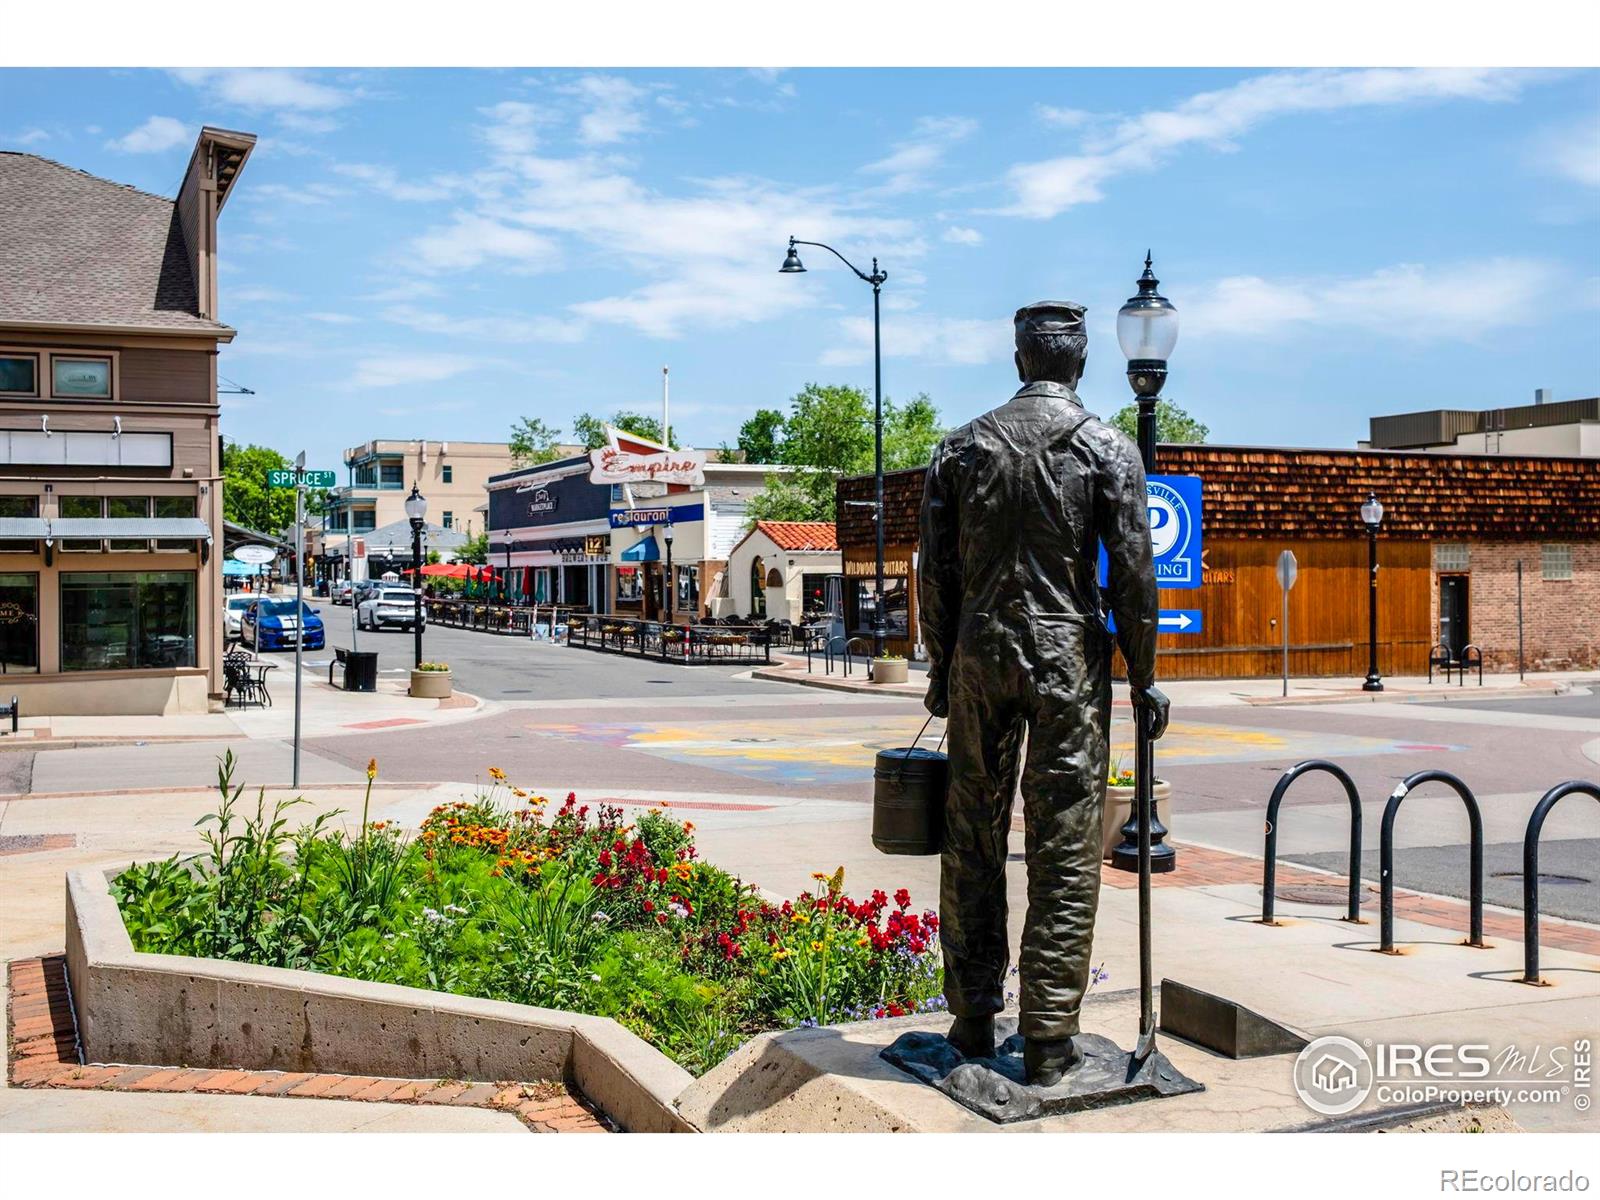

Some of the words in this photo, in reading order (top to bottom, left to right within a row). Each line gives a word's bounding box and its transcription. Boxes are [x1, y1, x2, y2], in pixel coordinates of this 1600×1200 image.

[602, 455, 697, 479] Empire
[272, 471, 321, 485] SPRUCE
[1146, 486, 1183, 511] SVILLE
[612, 510, 669, 523] restaurant
[588, 537, 602, 549] 12
[1202, 571, 1235, 583] UITARS
